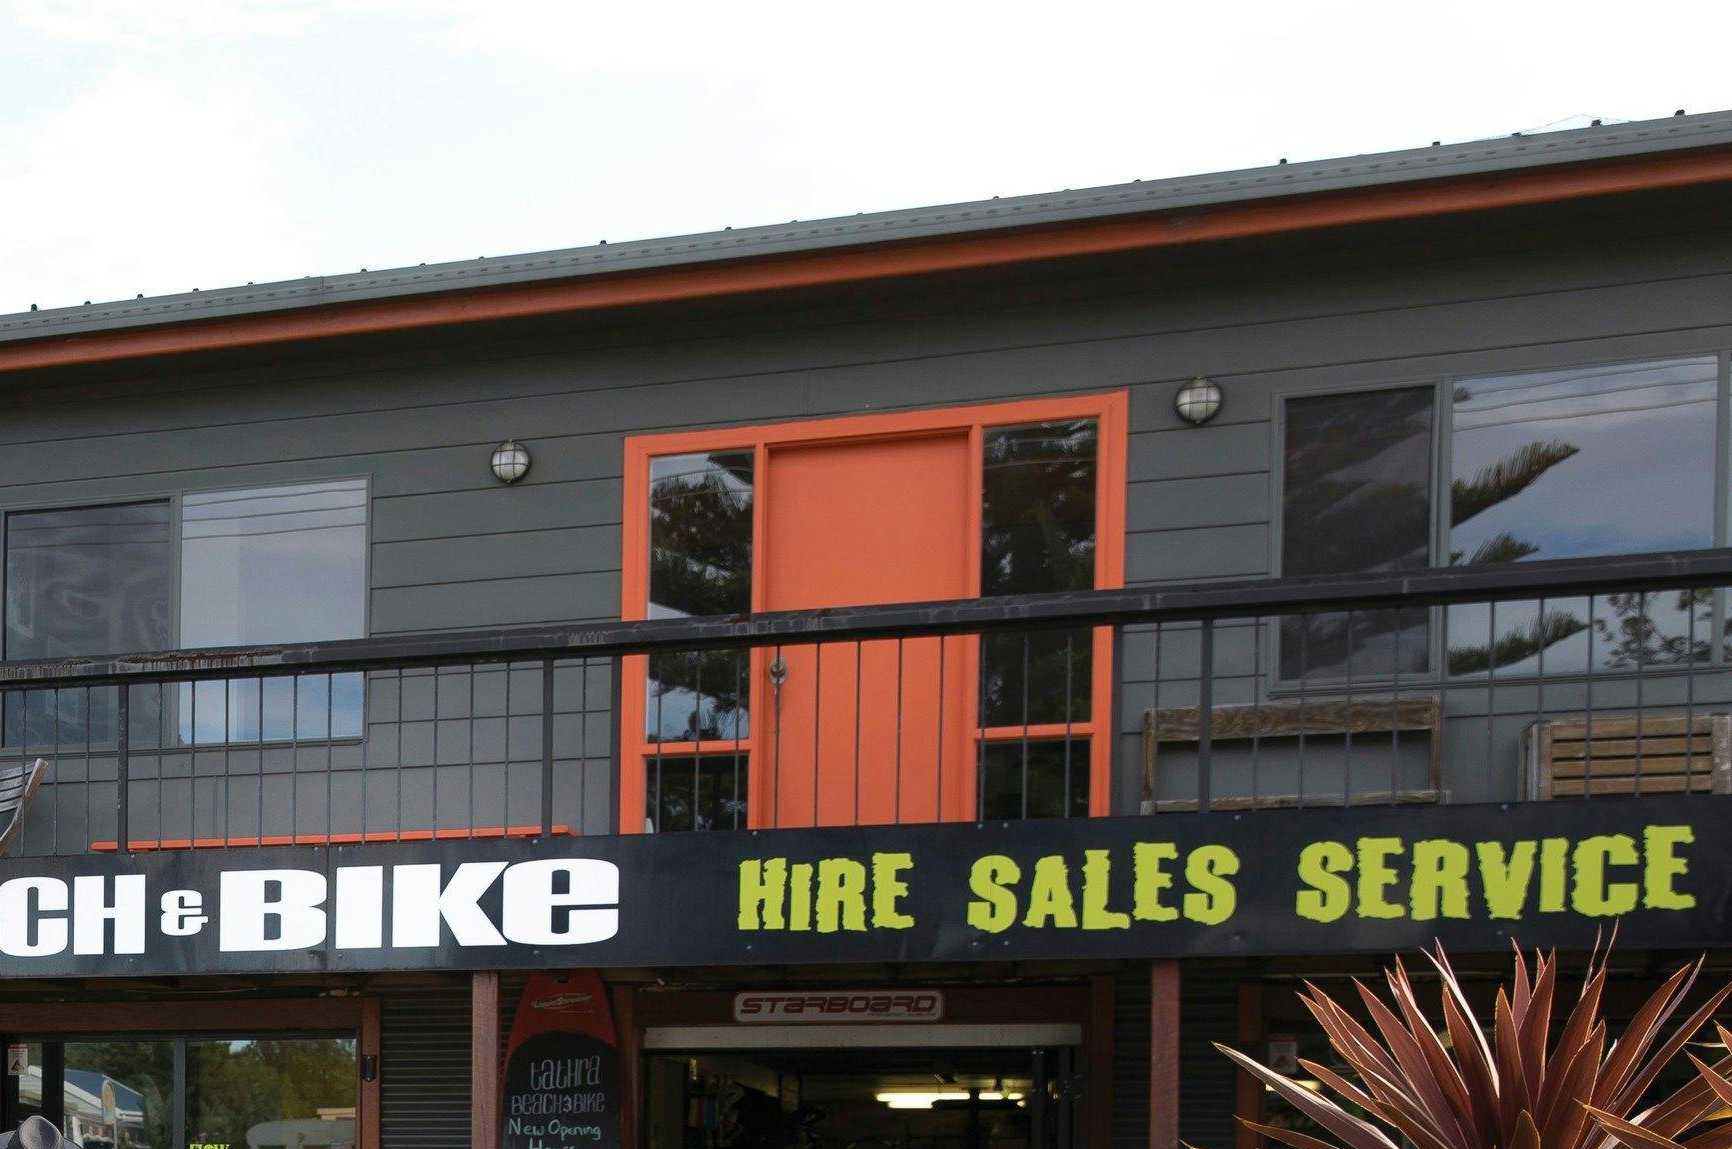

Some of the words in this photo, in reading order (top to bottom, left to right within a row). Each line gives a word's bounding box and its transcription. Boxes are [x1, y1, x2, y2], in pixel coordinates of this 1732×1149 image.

[737, 852, 914, 933] HIRE
[968, 841, 1240, 934] SALES
[1295, 824, 1696, 922] SERVICE
[160, 889, 208, 936] &
[508, 1118, 545, 1135] New
[548, 1119, 601, 1140] Opening
